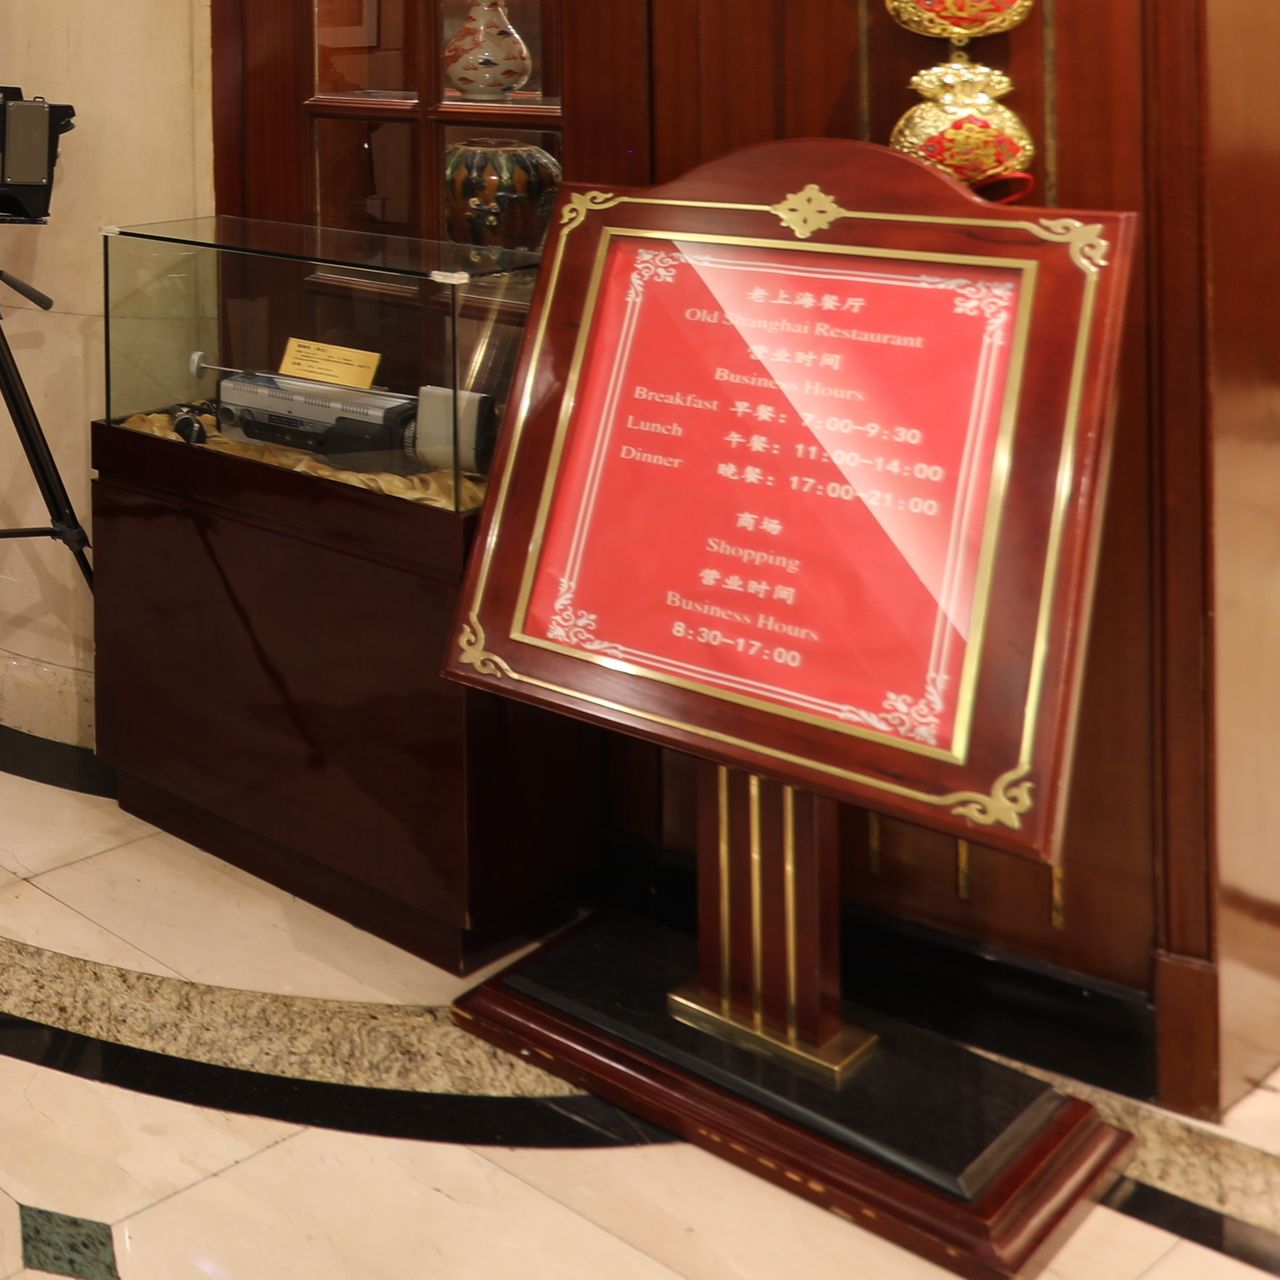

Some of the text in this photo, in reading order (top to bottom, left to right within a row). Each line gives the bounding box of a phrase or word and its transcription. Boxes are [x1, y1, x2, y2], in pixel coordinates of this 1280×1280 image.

[746, 286, 867, 314] 老上海餐厅
[684, 307, 924, 349] Old Shanghai Restaurant
[747, 344, 843, 371] 营业时间
[633, 385, 719, 412] Breakfast
[714, 367, 867, 403] Business Hours
[625, 415, 684, 438] Lunch
[619, 445, 684, 469] Dinner
[735, 511, 784, 536] 商场
[705, 537, 801, 574] Shopping
[698, 568, 797, 605] 营业时间
[665, 590, 820, 641] Business Hours
